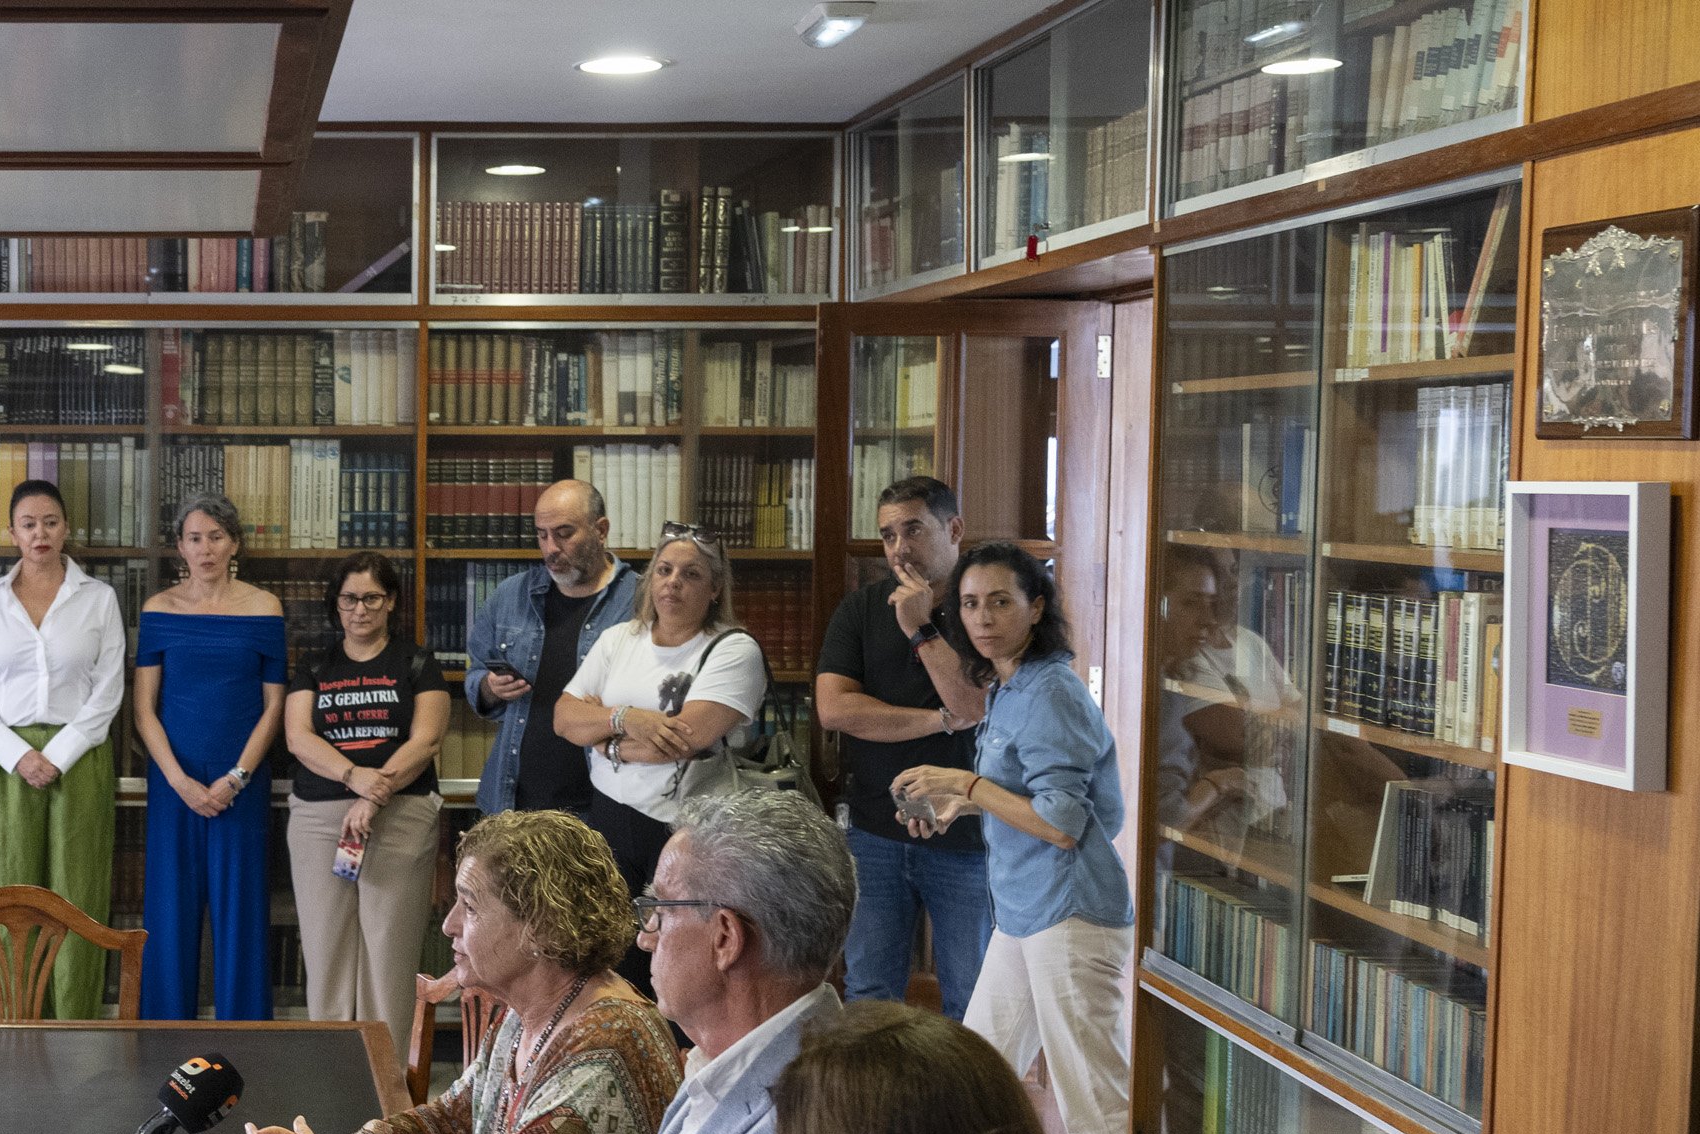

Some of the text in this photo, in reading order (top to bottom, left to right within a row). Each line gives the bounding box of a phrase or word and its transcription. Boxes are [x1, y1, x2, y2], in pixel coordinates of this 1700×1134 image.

[319, 675, 397, 691] Hospital Insular
[318, 690, 399, 709] ES GERIATRIA
[325, 709, 389, 723] NO AL CIERRE
[341, 727, 354, 739] LA
[355, 726, 399, 738] REFORMA
